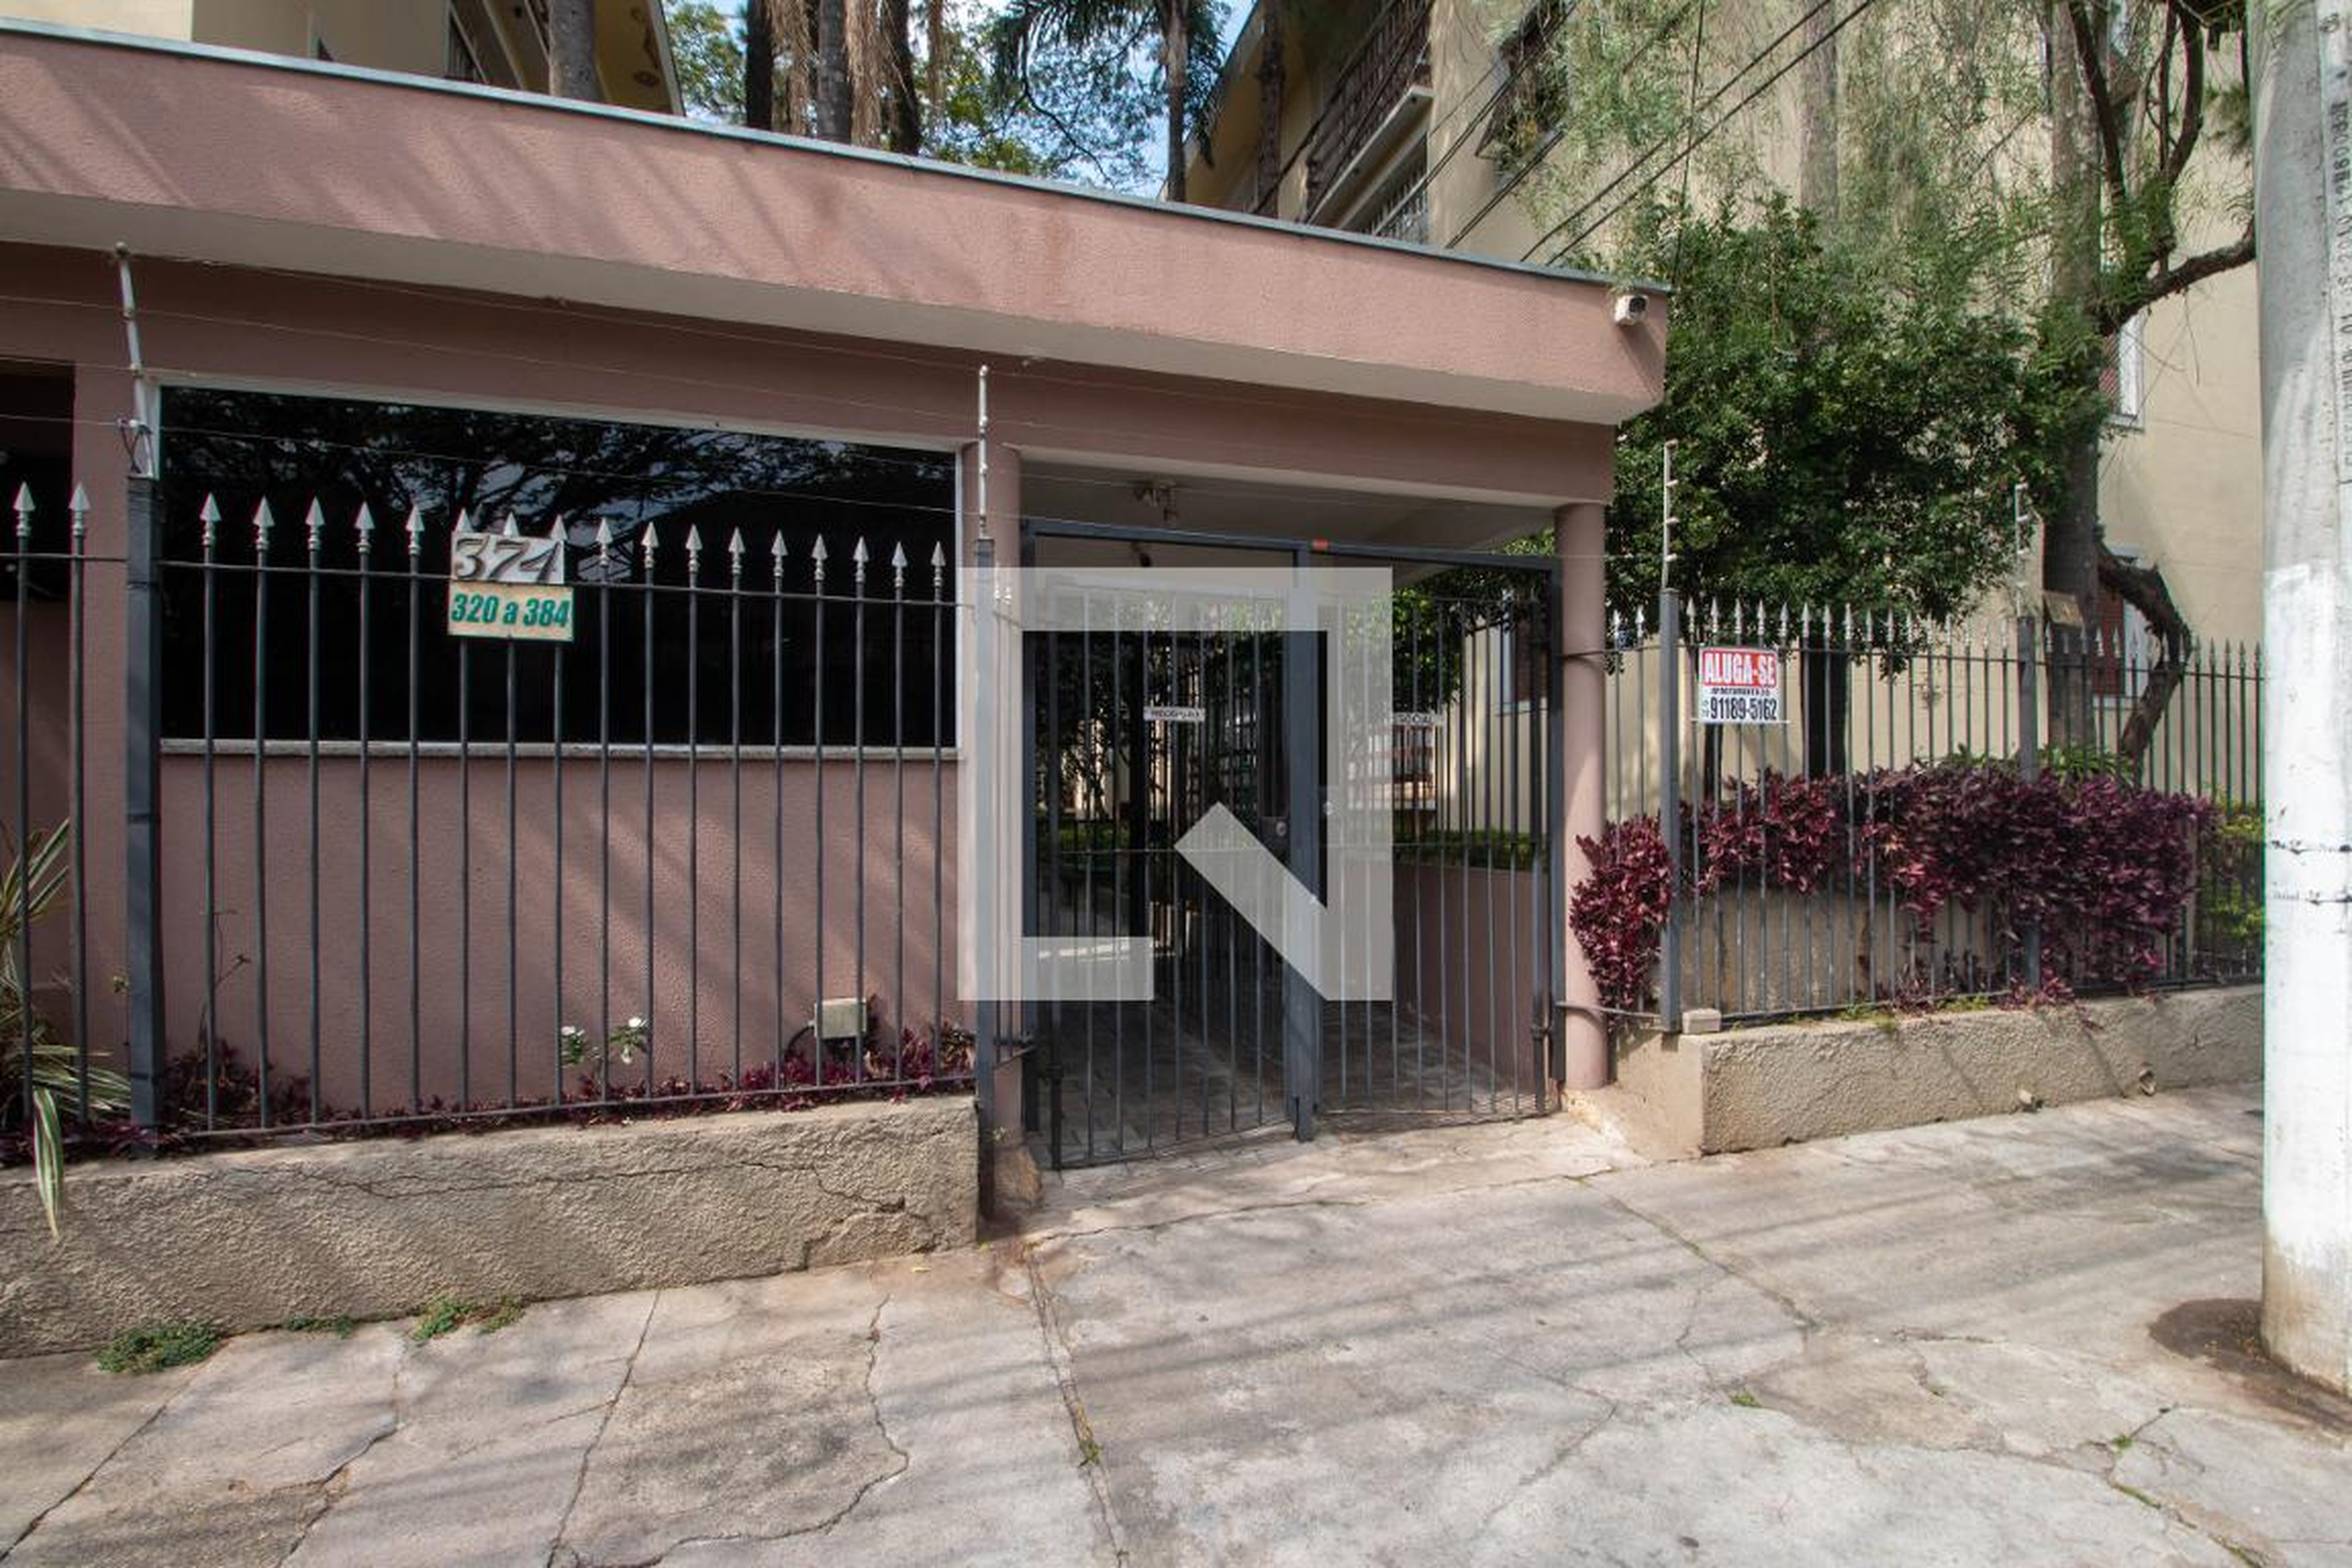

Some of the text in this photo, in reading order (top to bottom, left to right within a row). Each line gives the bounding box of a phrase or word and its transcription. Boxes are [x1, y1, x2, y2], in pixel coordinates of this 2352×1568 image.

[456, 535, 562, 582] 374
[450, 593, 571, 628] 320 a 384
[1704, 652, 1776, 685] ALUGA-SE
[1710, 696, 1777, 720] 91189-5162
